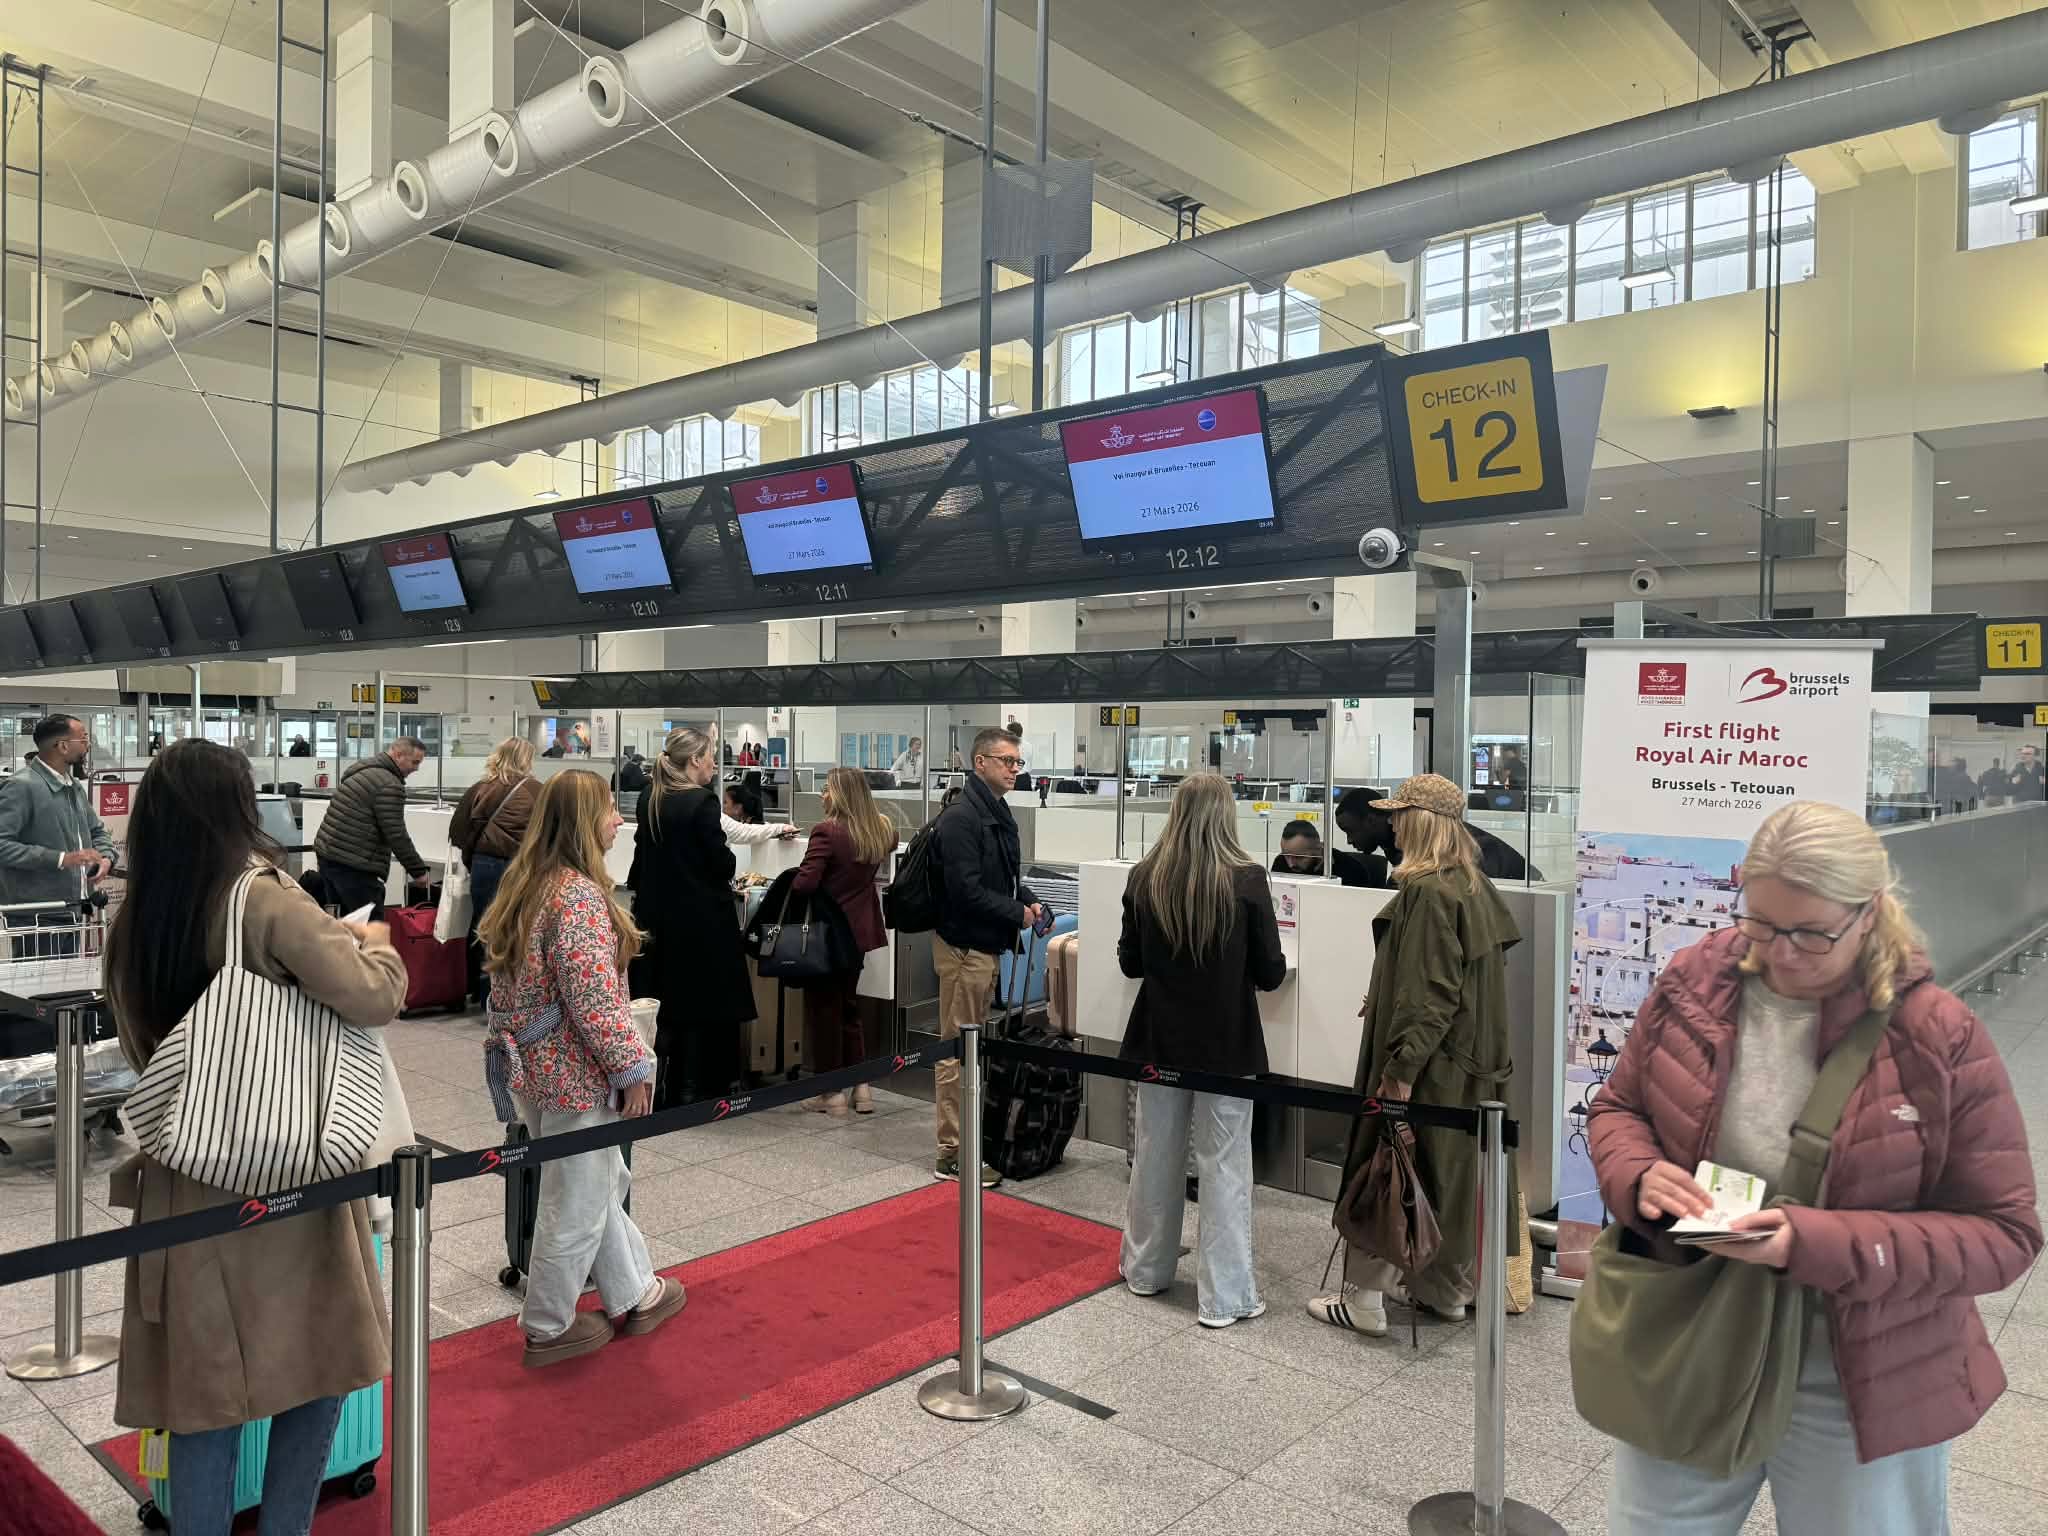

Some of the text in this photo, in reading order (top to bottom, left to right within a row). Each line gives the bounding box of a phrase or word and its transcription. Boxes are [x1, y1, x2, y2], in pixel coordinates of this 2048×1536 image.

[1421, 377, 1517, 409] CHECK-IN
[1428, 410, 1522, 482] 12
[1140, 502, 1201, 518] 27 Mars 2026
[1165, 545, 1221, 569] 12.12
[815, 583, 849, 602] 12.11
[1997, 639, 2028, 662] 11
[1789, 672, 1850, 685] brussels
[1789, 684, 1839, 698] airport
[1663, 721, 1781, 744] First flight
[1635, 746, 1808, 768] Royal Air Maroc
[1651, 777, 1716, 792] Brussels
[1730, 781, 1795, 796] Tetouan
[1681, 796, 1762, 810] 27 March 2026
[267, 1191, 303, 1206] brussels
[267, 1200, 298, 1214] airport
